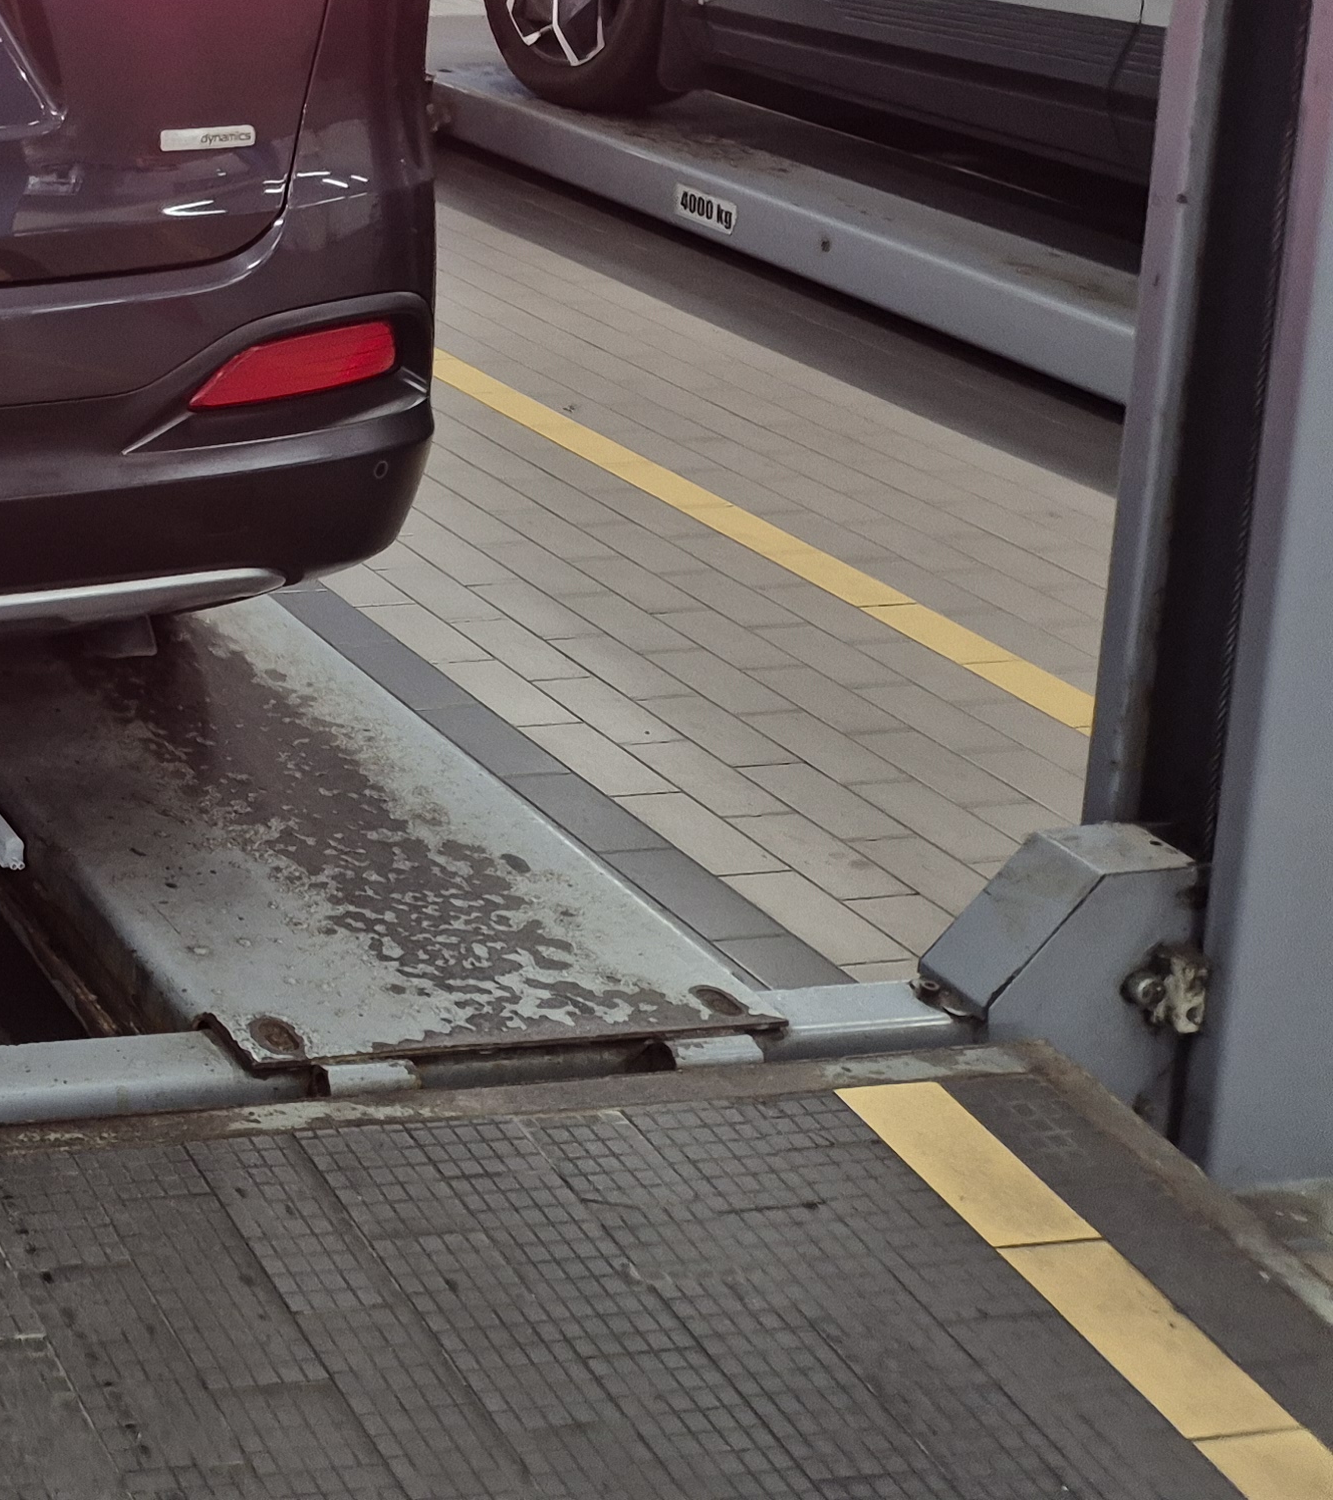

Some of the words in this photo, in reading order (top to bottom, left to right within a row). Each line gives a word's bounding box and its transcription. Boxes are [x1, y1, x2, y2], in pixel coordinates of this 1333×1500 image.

[200, 130, 252, 146] dynamics
[680, 190, 714, 220] 4000
[716, 203, 733, 230] kg
